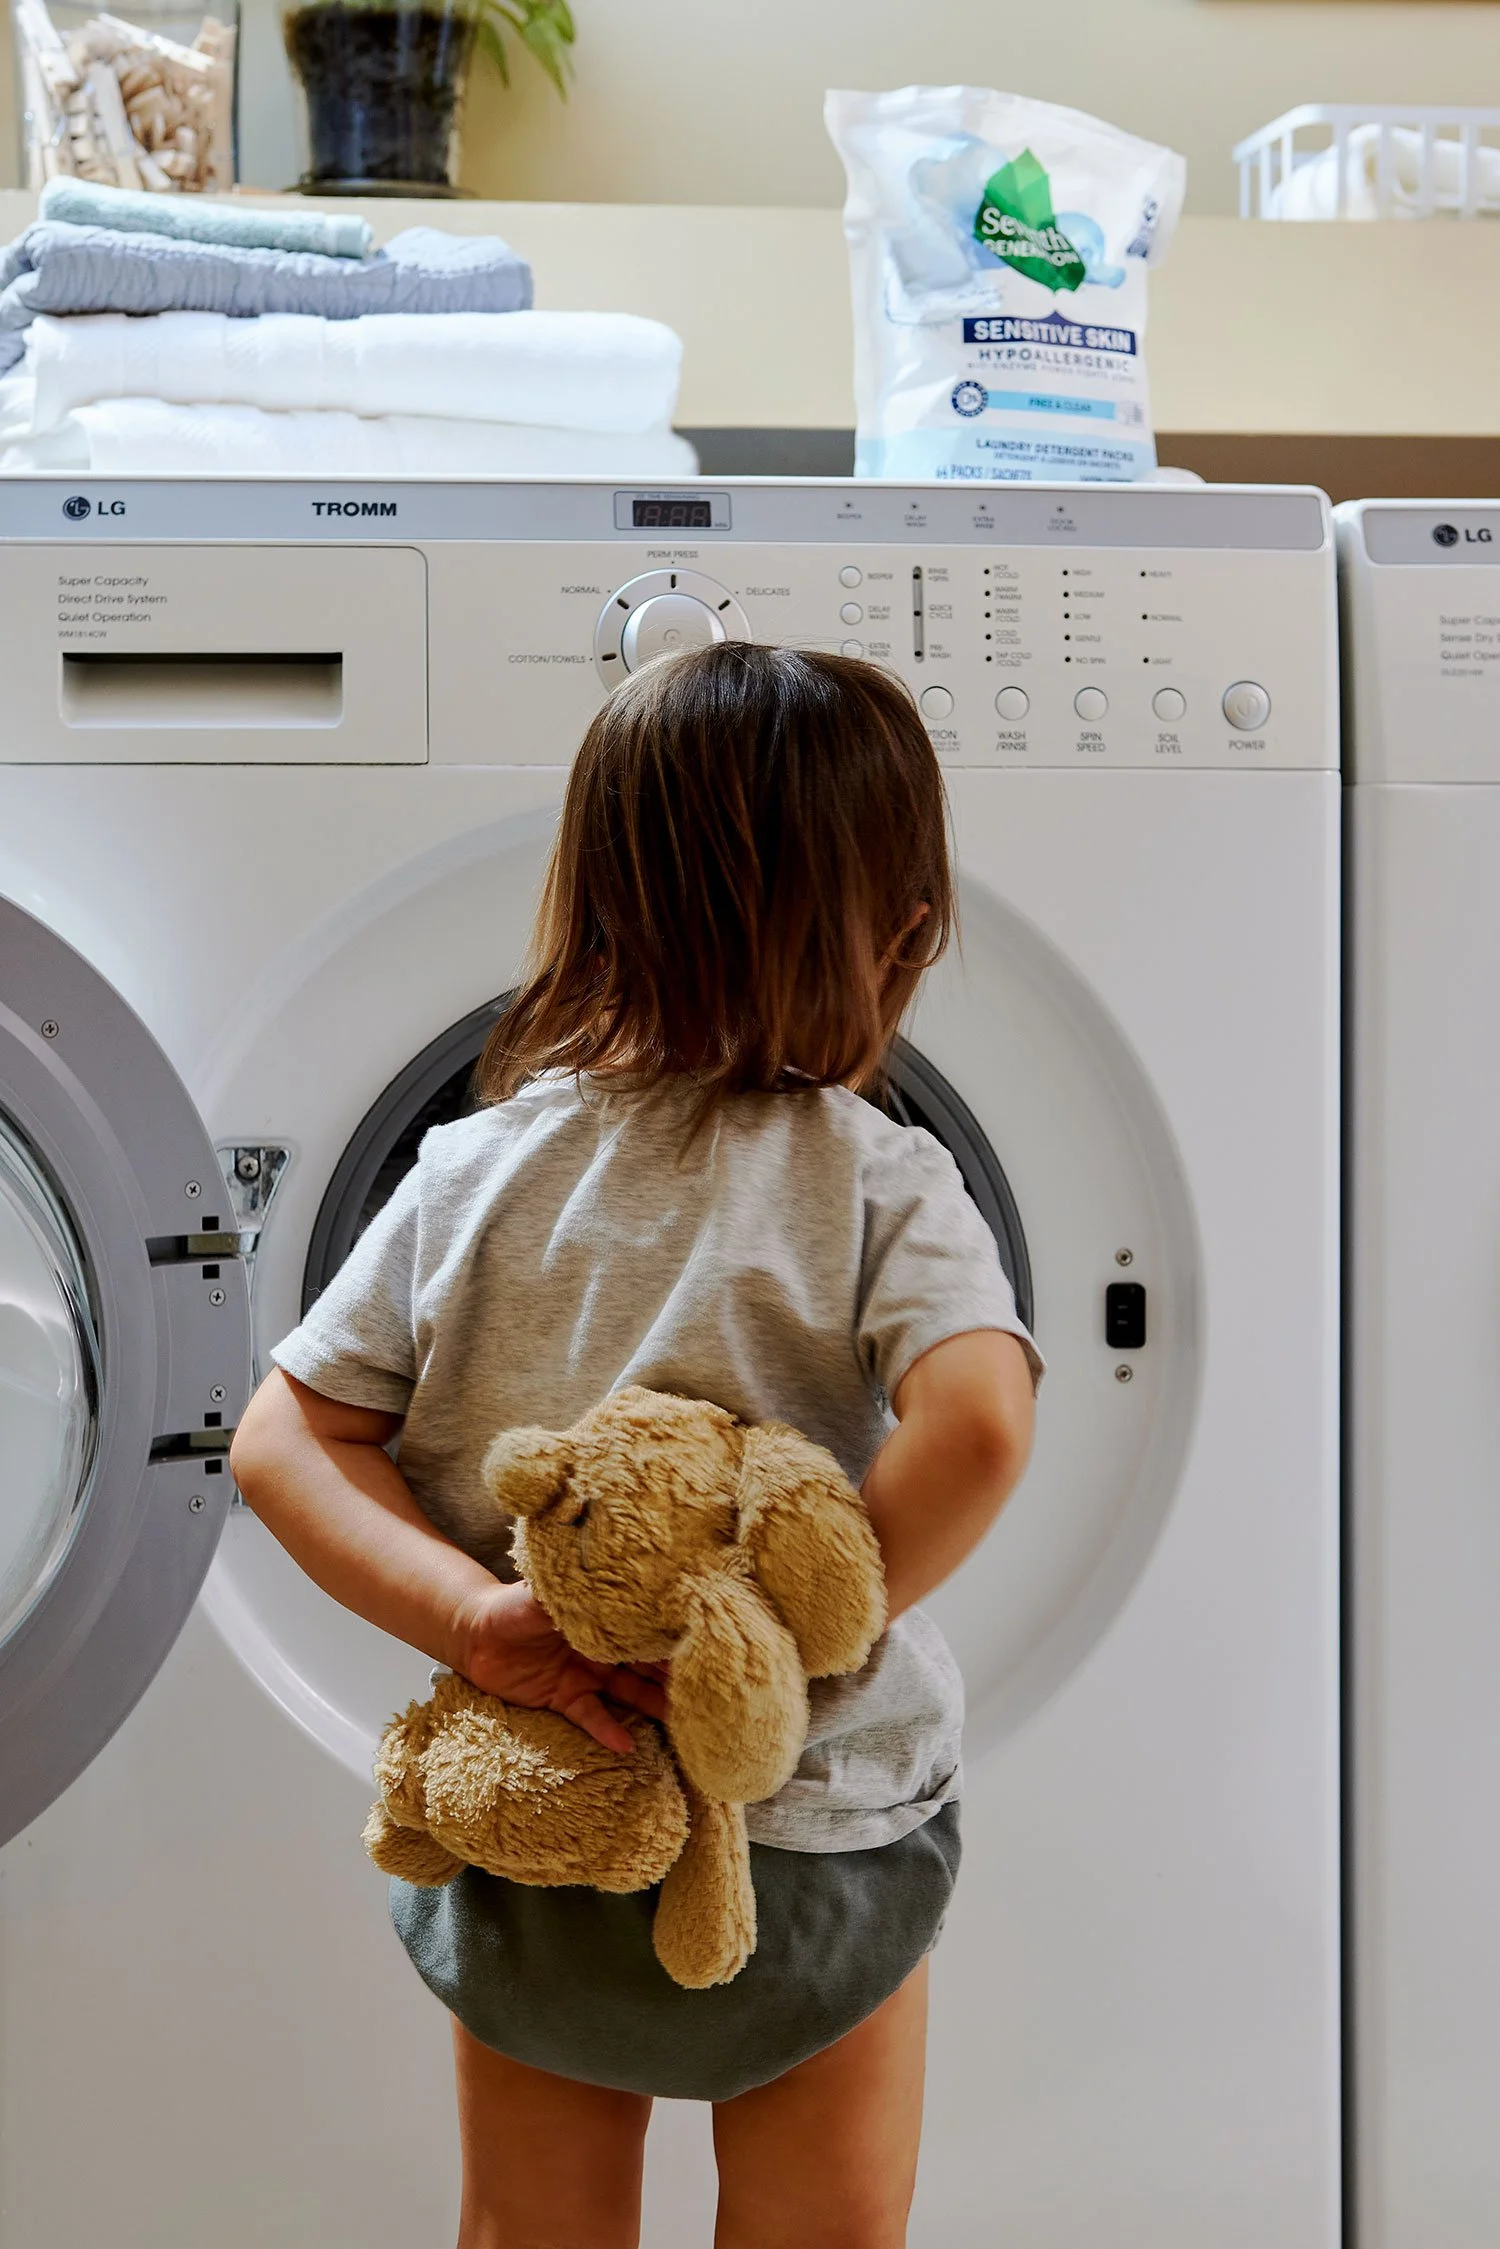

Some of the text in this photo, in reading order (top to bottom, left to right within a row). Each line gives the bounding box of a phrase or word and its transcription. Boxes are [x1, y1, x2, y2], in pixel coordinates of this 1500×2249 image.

[974, 319, 1131, 352] SENSITIVE SKIN
[979, 348, 1129, 372] HYPOALLERGENIC
[1028, 396, 1051, 407] FREE
[976, 438, 1135, 462] LAUNDRY DETERGENT PACKS
[951, 464, 982, 480] PACKS
[991, 467, 1033, 480] SACHETS
[98, 501, 126, 515] LG
[311, 501, 397, 516] TROMM
[1465, 528, 1492, 543] LG
[647, 550, 699, 559] PERM PRESS
[58, 576, 149, 587] Super Capacity
[561, 586, 601, 594] NORMAL
[746, 586, 791, 596] DELICATES
[58, 594, 168, 605] Direct Drive System
[58, 611, 151, 623] Quiet Operation
[1440, 614, 1471, 626] Super
[508, 654, 587, 664] COTTON/TOWELS
[1011, 652, 1032, 660] COLD
[927, 730, 957, 739] TION
[998, 731, 1026, 740] WASH
[1080, 732, 1102, 741] SPIN
[1158, 733, 1179, 742] SOIL
[996, 741, 1028, 751] /RINSE
[1077, 742, 1106, 752] SPEED
[1155, 744, 1182, 753] LEVEL
[1228, 740, 1266, 750] POWER
